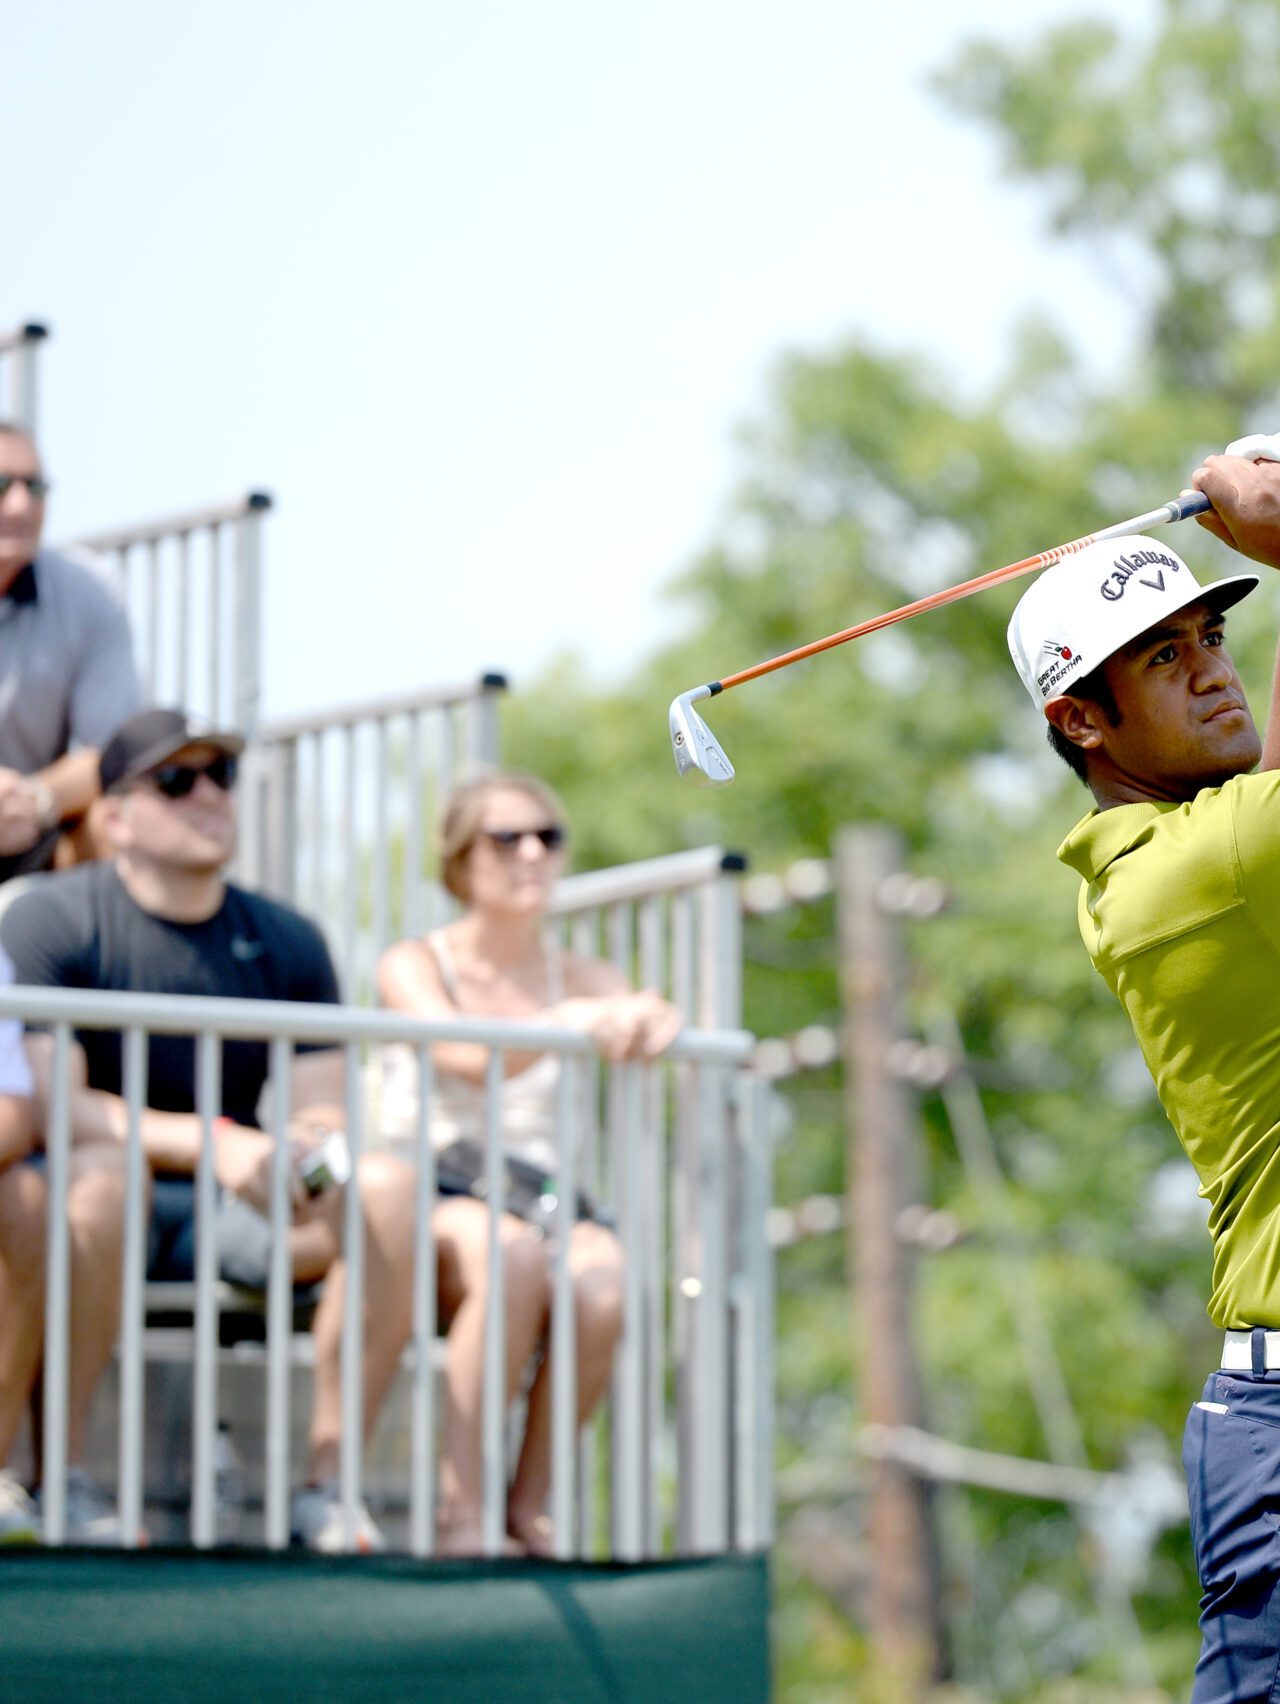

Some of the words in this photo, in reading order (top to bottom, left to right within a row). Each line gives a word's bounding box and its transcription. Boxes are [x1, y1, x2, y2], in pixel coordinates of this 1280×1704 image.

[1100, 550, 1180, 601] Callaway
[1037, 660, 1060, 687] GREAT
[1041, 682, 1051, 697] BIG
[1049, 654, 1083, 686] BERTHA
